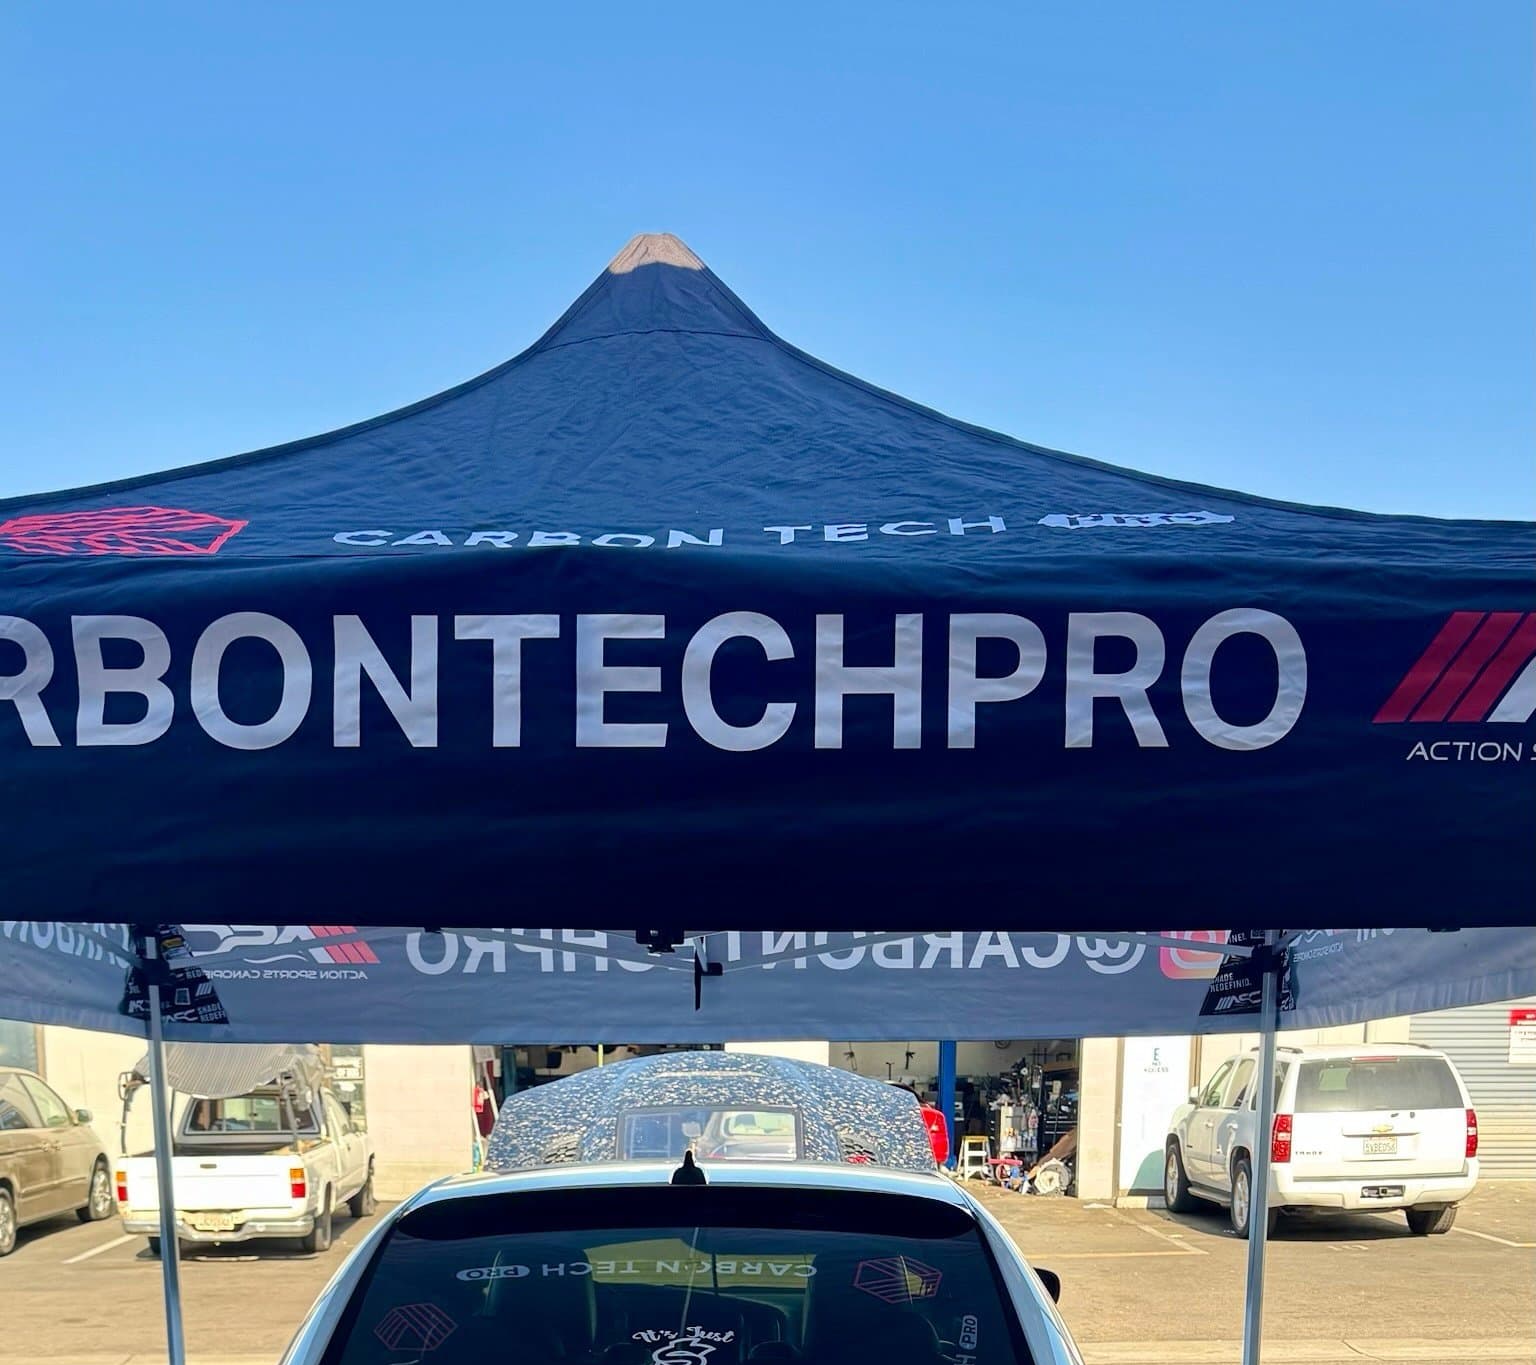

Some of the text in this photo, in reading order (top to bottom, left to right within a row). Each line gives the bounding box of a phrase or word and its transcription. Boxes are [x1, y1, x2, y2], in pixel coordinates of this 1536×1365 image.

[332, 528, 724, 548] CARBON
[763, 515, 1007, 545] TECH
[1406, 741, 1523, 761] ACTION
[686, 1326, 735, 1343] Just
